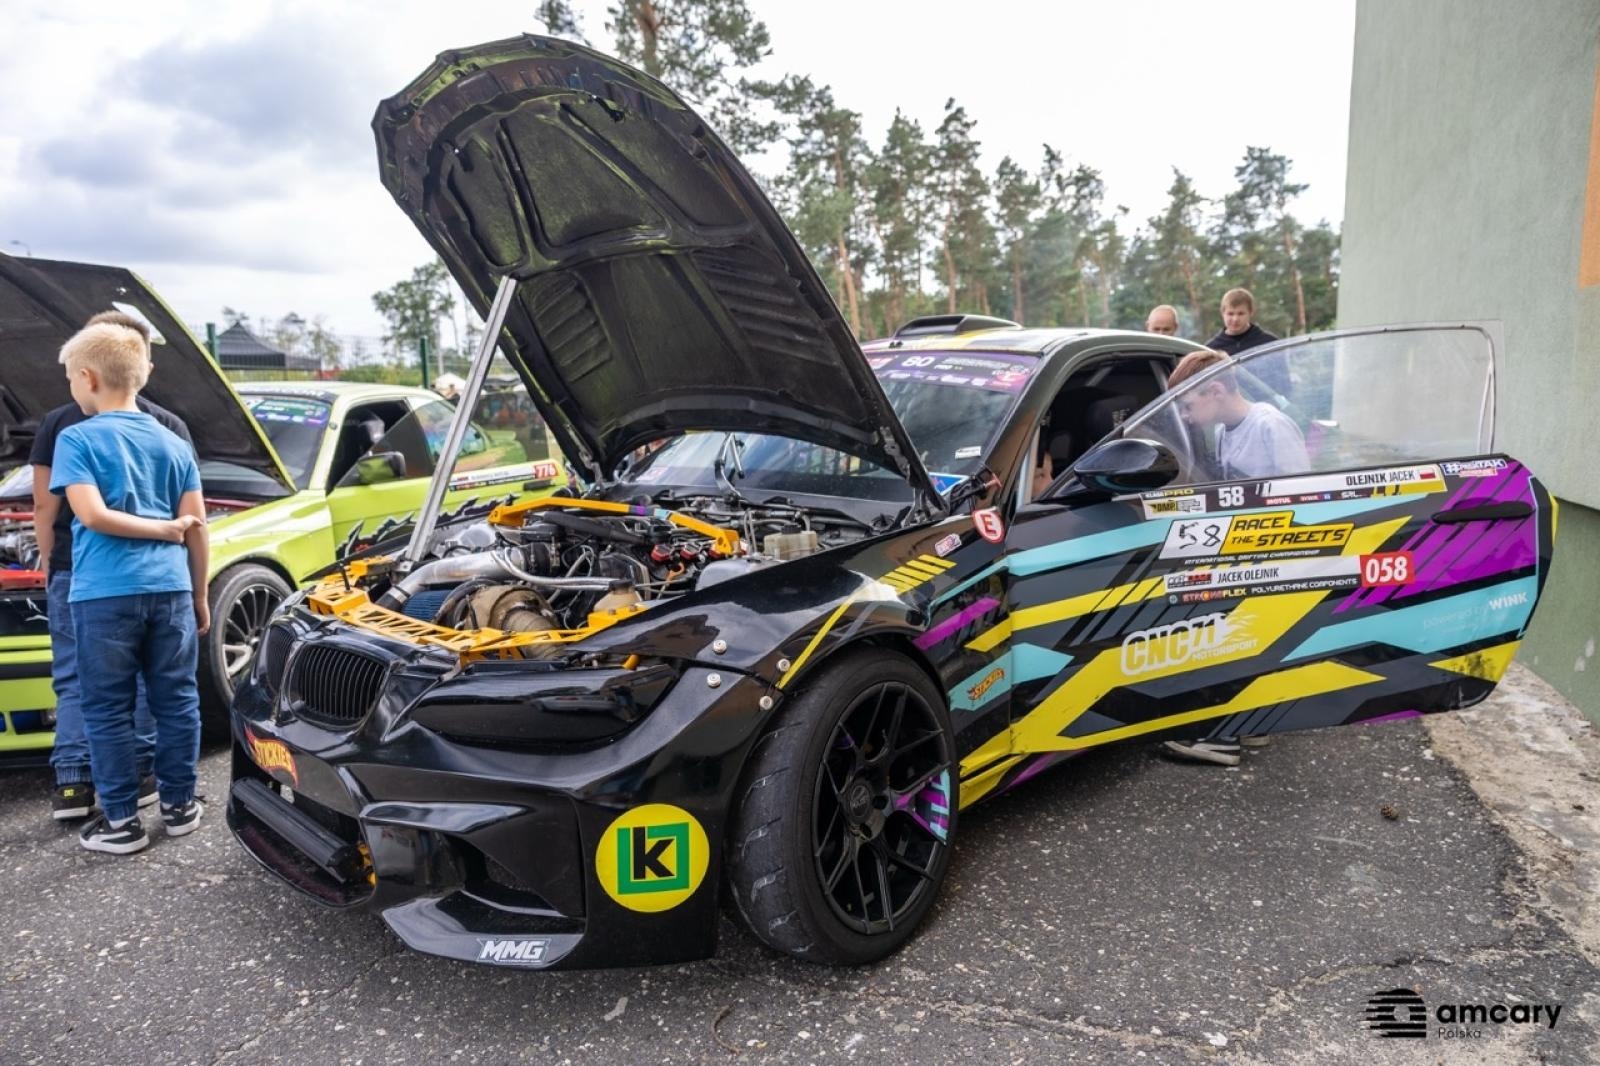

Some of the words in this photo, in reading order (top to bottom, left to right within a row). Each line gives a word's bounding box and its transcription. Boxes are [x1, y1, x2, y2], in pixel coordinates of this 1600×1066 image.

[1345, 473, 1387, 486] OLEJNIK
[1388, 469, 1416, 483] JACEK
[1164, 488, 1194, 497] PRO
[1218, 486, 1245, 507] 58
[980, 514, 997, 534] E
[1233, 516, 1286, 531] RACE
[1179, 522, 1221, 549] 58
[1231, 535, 1254, 545] THE
[1255, 528, 1347, 547] STREETS
[1184, 555, 1236, 565] INTERNATIONAL
[1217, 570, 1243, 584] JACEK
[1244, 567, 1279, 582] OLEJNIK
[1365, 556, 1408, 583] 058
[1251, 583, 1309, 595] POLYURETHANE
[1309, 578, 1358, 589] COMPONENTS
[1489, 592, 1528, 610] WINK
[1121, 612, 1231, 676] CNC71
[480, 940, 546, 961] MMG
